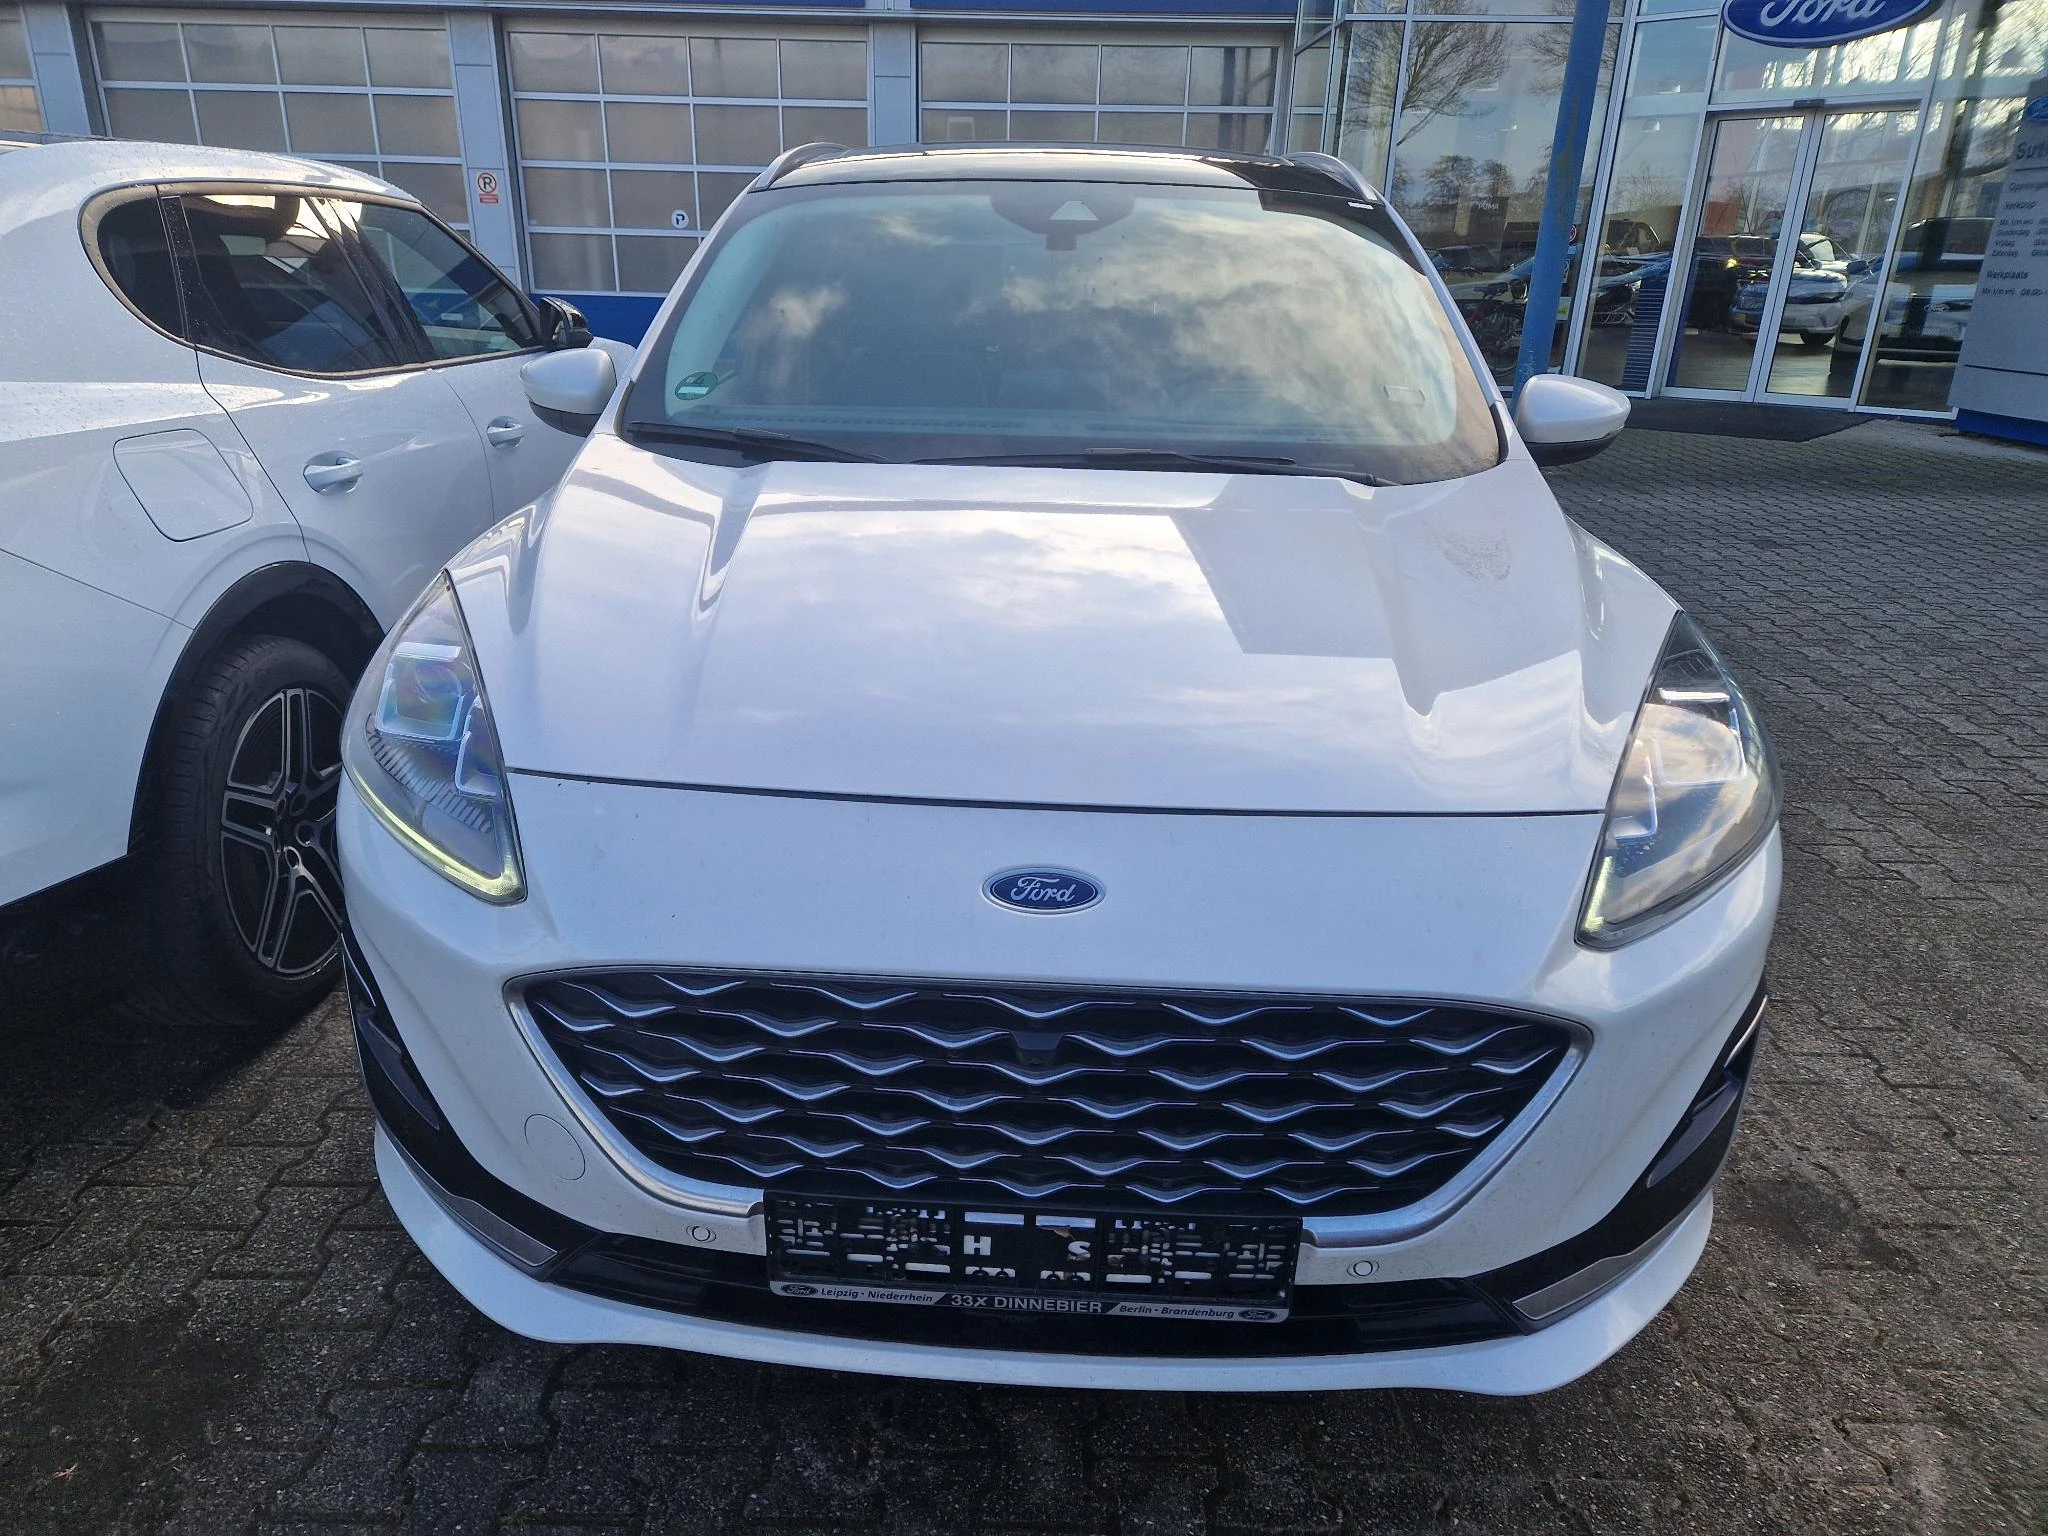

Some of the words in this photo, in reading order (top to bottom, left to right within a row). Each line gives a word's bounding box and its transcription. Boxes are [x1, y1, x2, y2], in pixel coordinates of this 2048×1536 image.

[1986, 270, 2029, 281] Werkplaats
[1010, 876, 1078, 902] Ford
[821, 1287, 859, 1299] Leipzig
[867, 1290, 933, 1302] Niederrhein
[994, 1296, 1103, 1314] DINNEBIER
[1119, 1305, 1152, 1314] Berlin
[1161, 1307, 1235, 1320] Brandenburg
